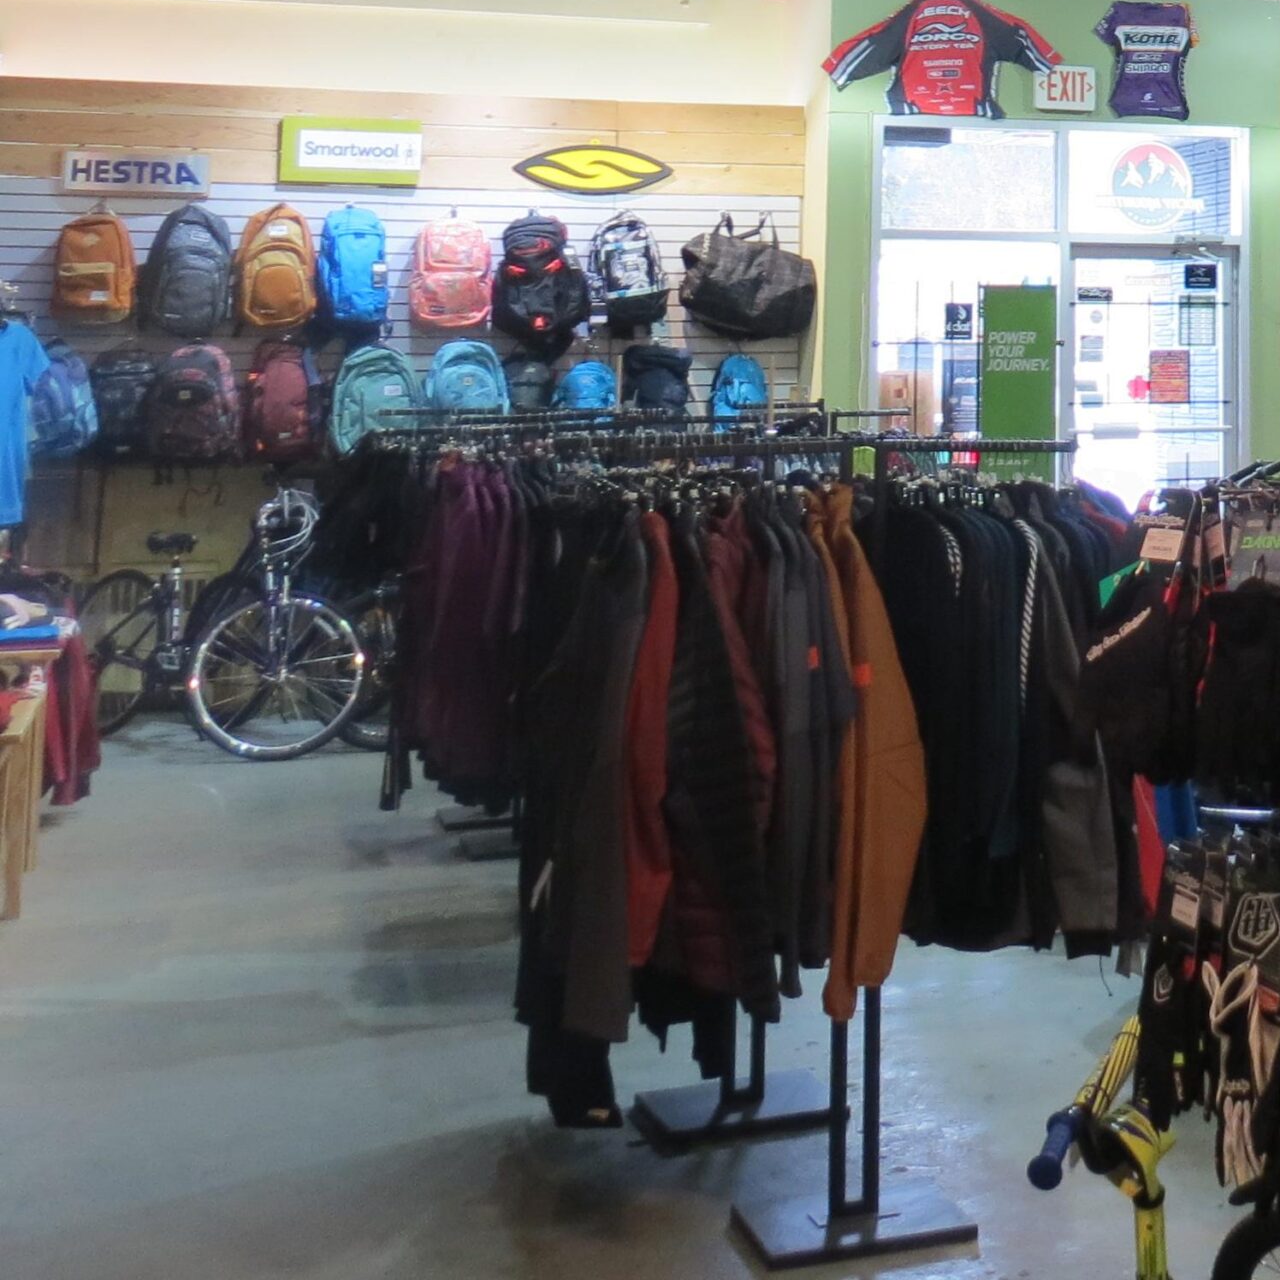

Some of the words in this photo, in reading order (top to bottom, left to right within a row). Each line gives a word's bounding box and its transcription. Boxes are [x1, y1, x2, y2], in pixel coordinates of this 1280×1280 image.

[1047, 70, 1088, 103] EXIT
[303, 140, 399, 159] Smartwool
[71, 159, 200, 186] HESTRA
[988, 331, 1037, 345] POWER
[988, 345, 1026, 358] YOUR
[986, 358, 1050, 371] JOURNEY.
